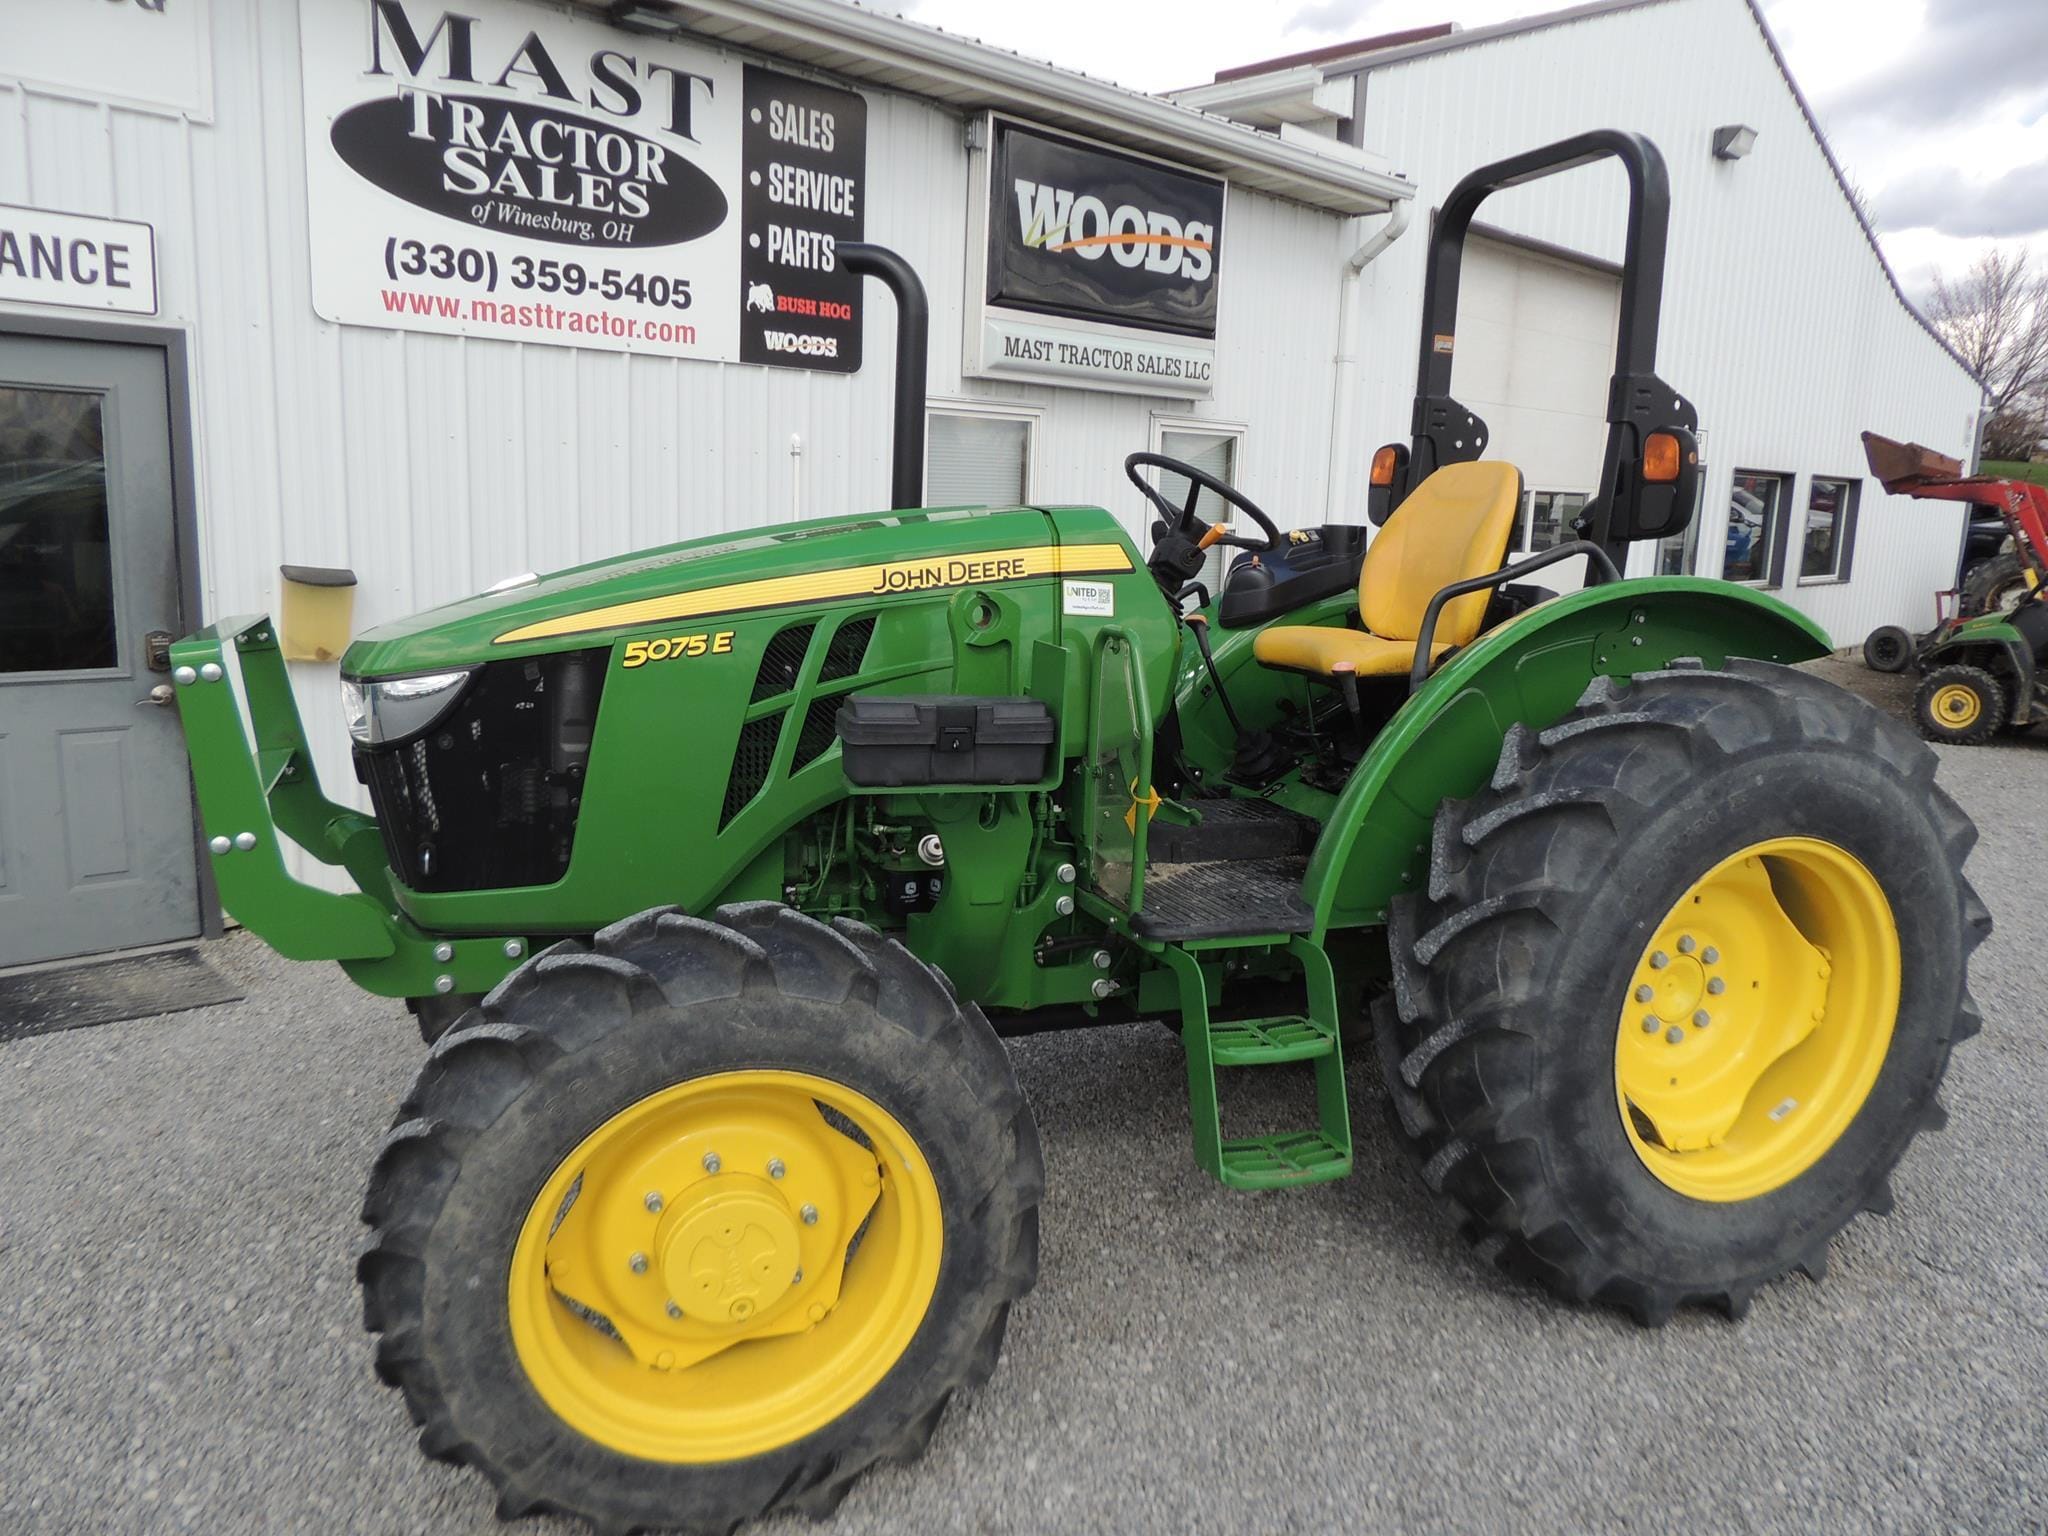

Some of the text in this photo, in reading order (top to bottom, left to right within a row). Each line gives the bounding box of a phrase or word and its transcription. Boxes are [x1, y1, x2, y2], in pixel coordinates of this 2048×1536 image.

[363, 0, 714, 145] MAST
[398, 84, 669, 185] TRACTOR
[769, 99, 835, 153] SALES
[443, 147, 650, 218] SALES
[768, 162, 855, 217] SERVICE
[471, 200, 635, 243] of Winesburg, OH
[1014, 178, 1214, 282] WOODS
[384, 236, 693, 310] (330) 359-5405
[767, 223, 835, 273] PARTS
[380, 289, 697, 345] www.masttractor.com
[777, 295, 852, 321] BUSH HOG
[764, 329, 838, 358] WOODS
[1004, 336, 1211, 381] MAST TRACTOR SALES LLC
[873, 558, 1025, 591] JOHN DEERE
[1066, 586, 1097, 598] UNITED
[622, 634, 709, 668] 5075
